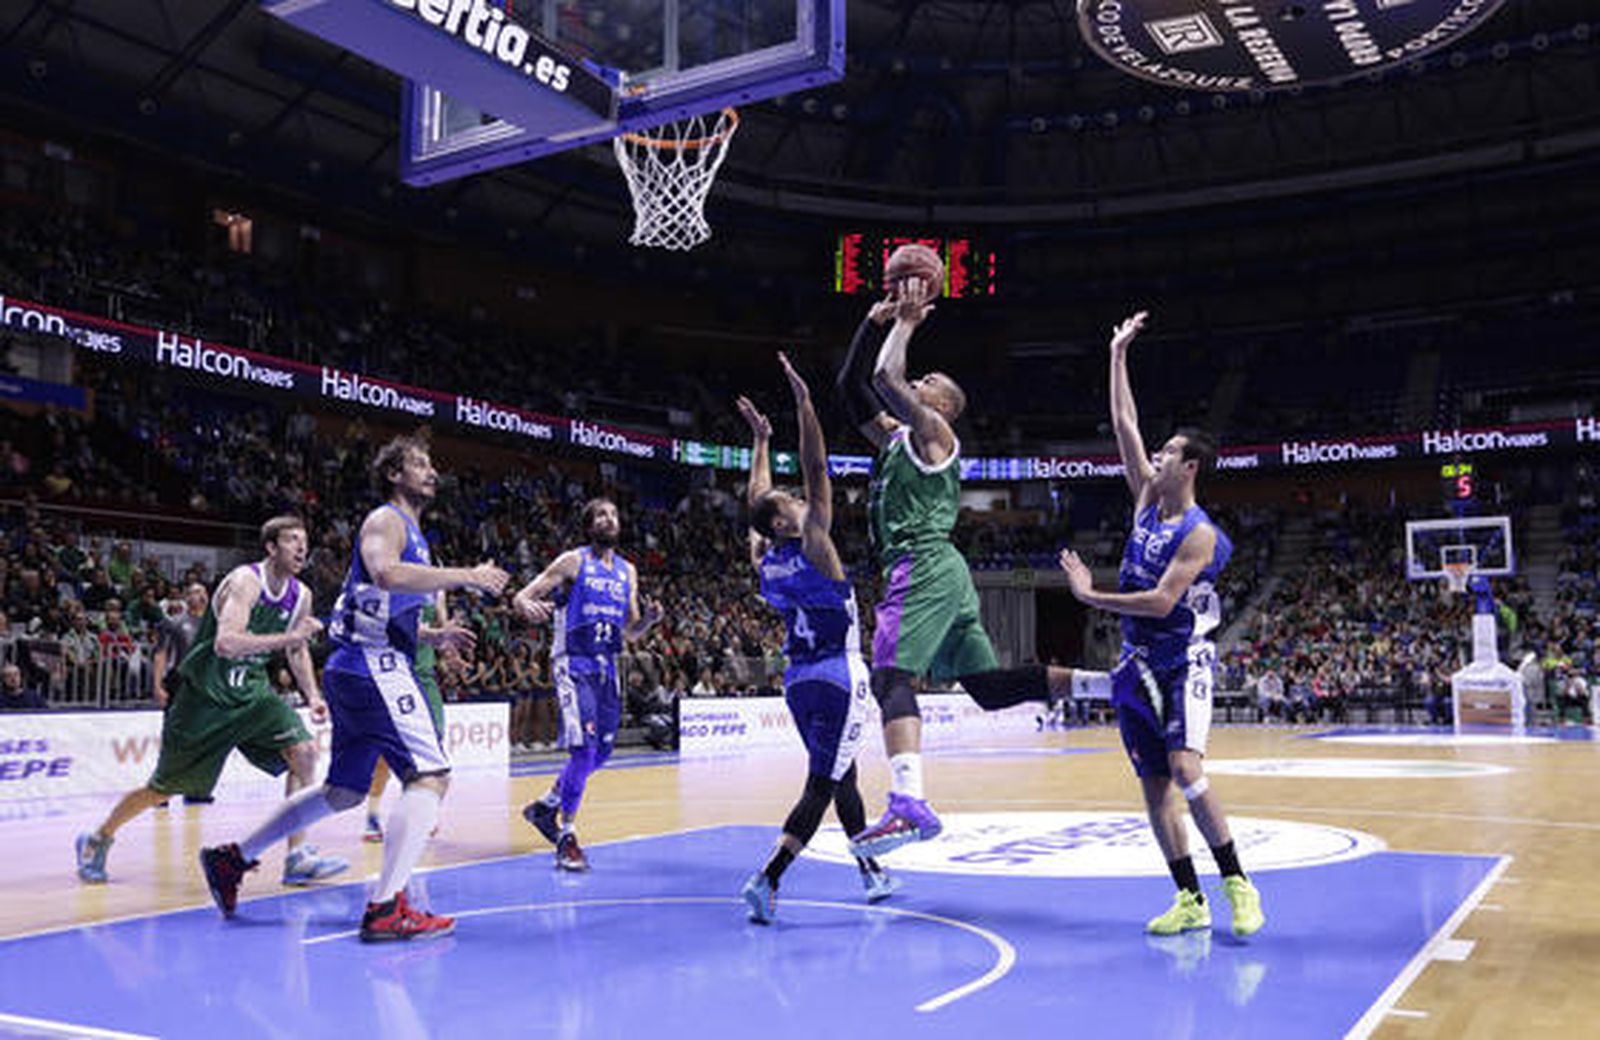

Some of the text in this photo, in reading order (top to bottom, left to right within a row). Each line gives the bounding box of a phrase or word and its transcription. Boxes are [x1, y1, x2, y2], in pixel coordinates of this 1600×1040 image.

[393, 0, 571, 92] ertia.es
[1457, 475, 1471, 498] 5
[794, 605, 816, 649] 4
